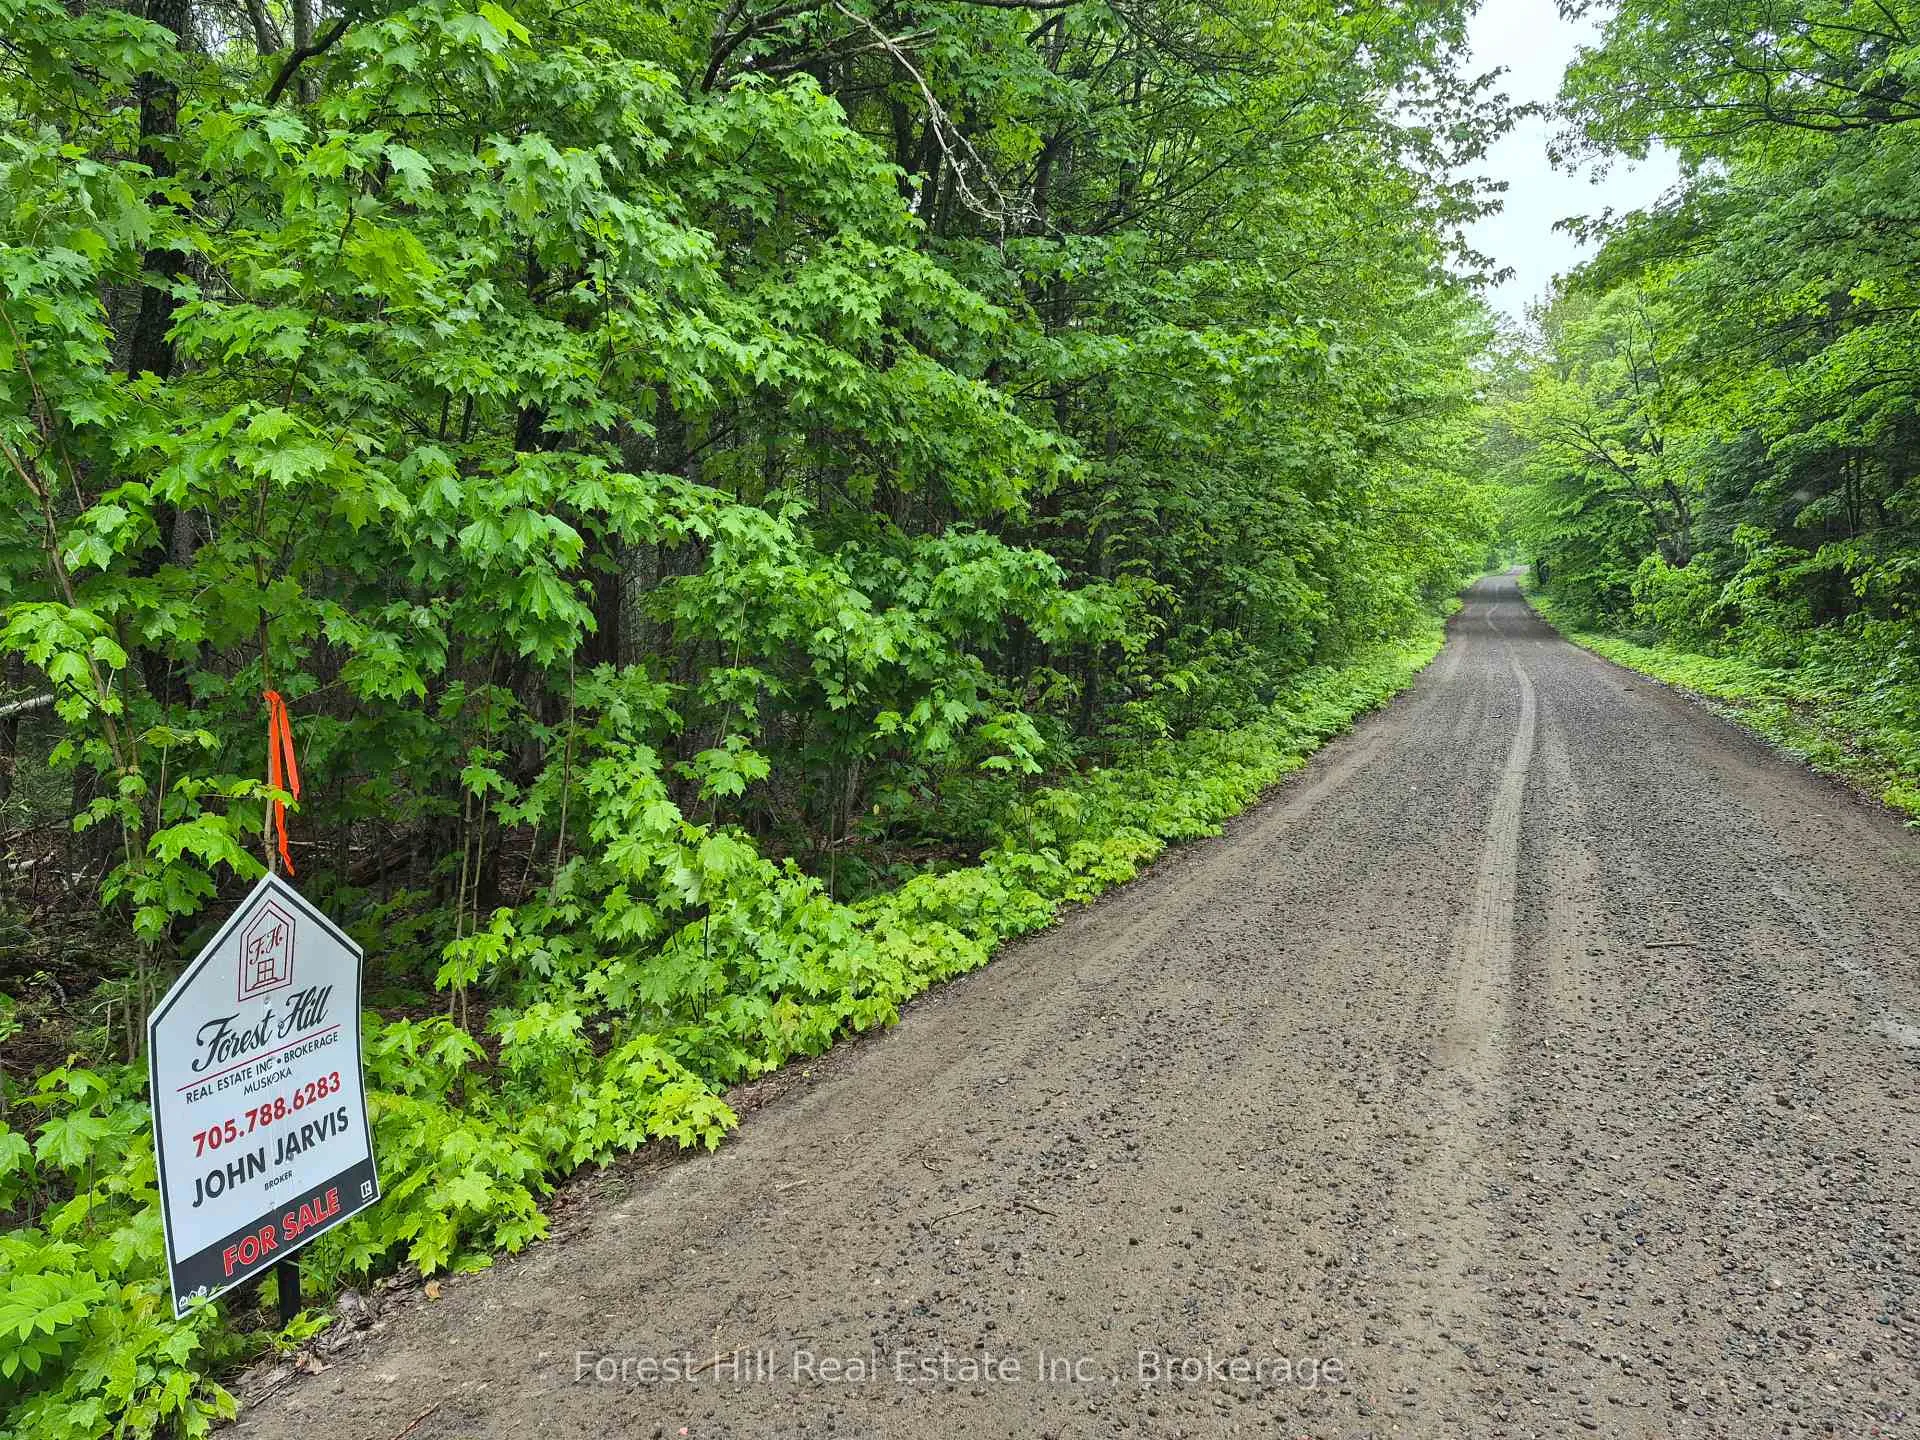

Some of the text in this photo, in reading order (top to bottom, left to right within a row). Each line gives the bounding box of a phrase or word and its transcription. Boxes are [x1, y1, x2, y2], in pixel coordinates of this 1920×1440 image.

[186, 1085, 213, 1105] REAL
[217, 1067, 253, 1091] ESTATE
[284, 1031, 339, 1064] BROKERAGE
[192, 984, 333, 1072] Forest Hill
[192, 1071, 341, 1158] 705.788.6283
[244, 1067, 292, 1096] MUSKOKA
[192, 1106, 349, 1208] JOHN JARVIS
[264, 1170, 294, 1191] BROKER
[223, 1187, 341, 1279] FOR SALE
